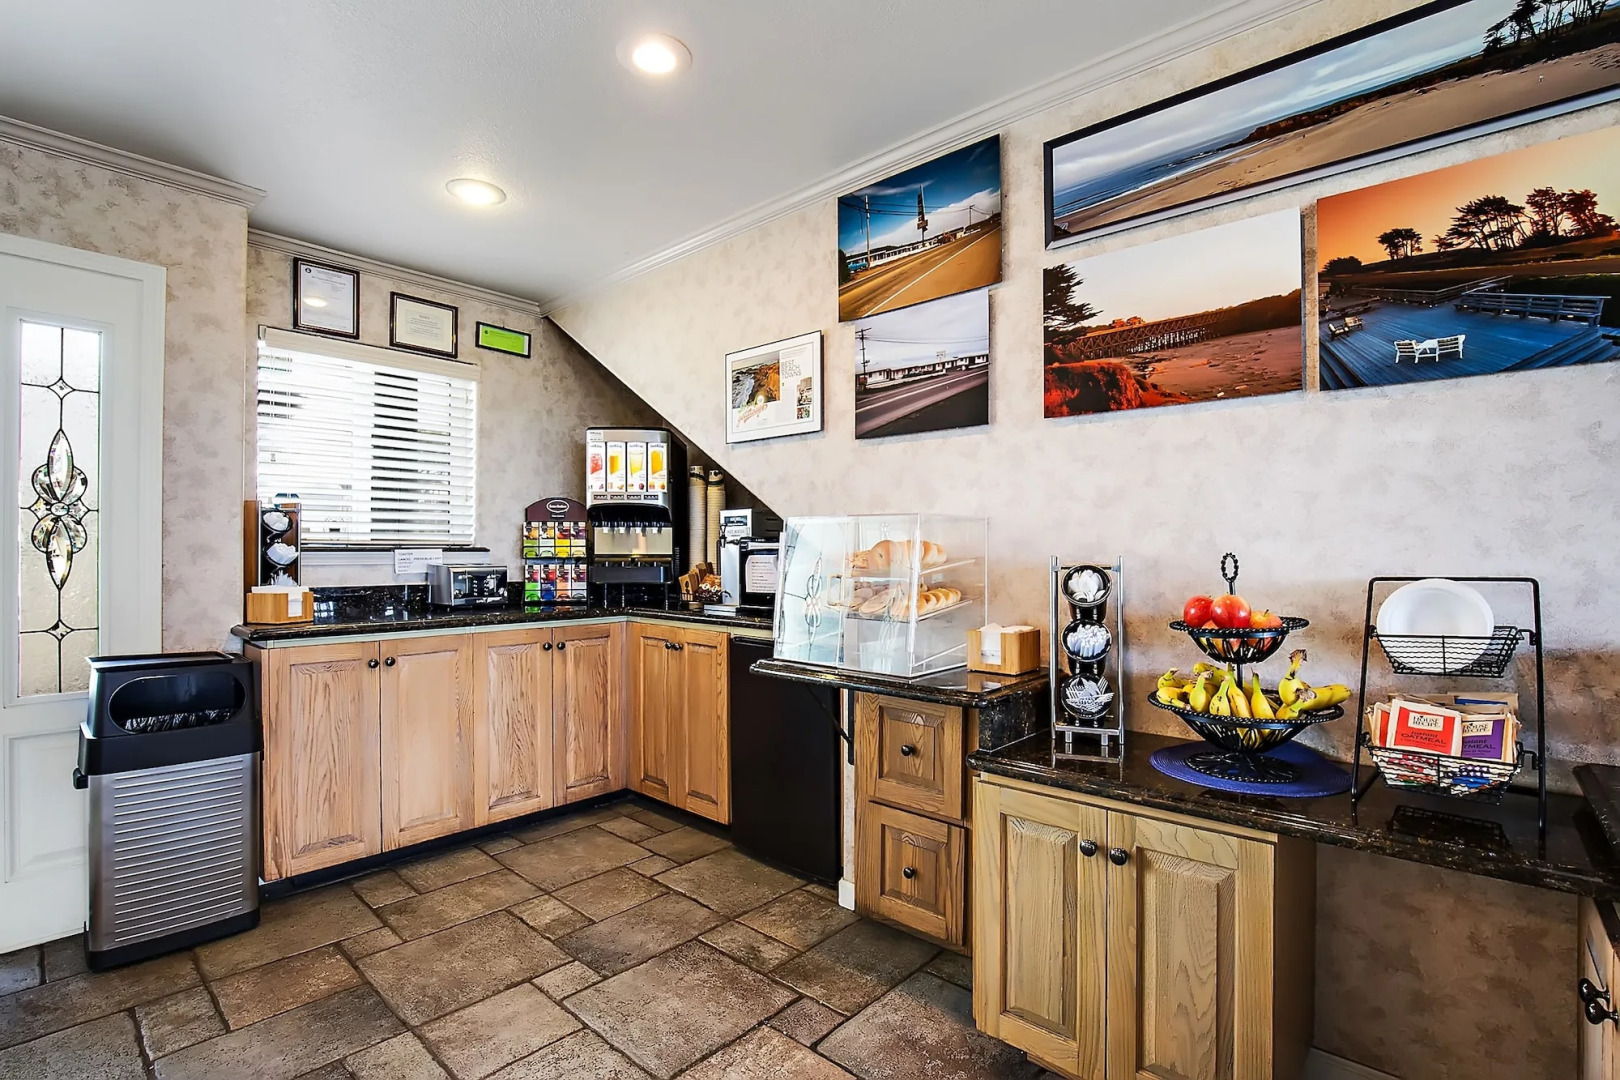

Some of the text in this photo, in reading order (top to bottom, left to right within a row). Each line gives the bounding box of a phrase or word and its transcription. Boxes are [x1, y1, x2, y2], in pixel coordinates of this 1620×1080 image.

[1413, 716, 1439, 724] HOUSE
[1413, 720, 1440, 728] RECIPE
[1401, 733, 1447, 744] OATMEAL
